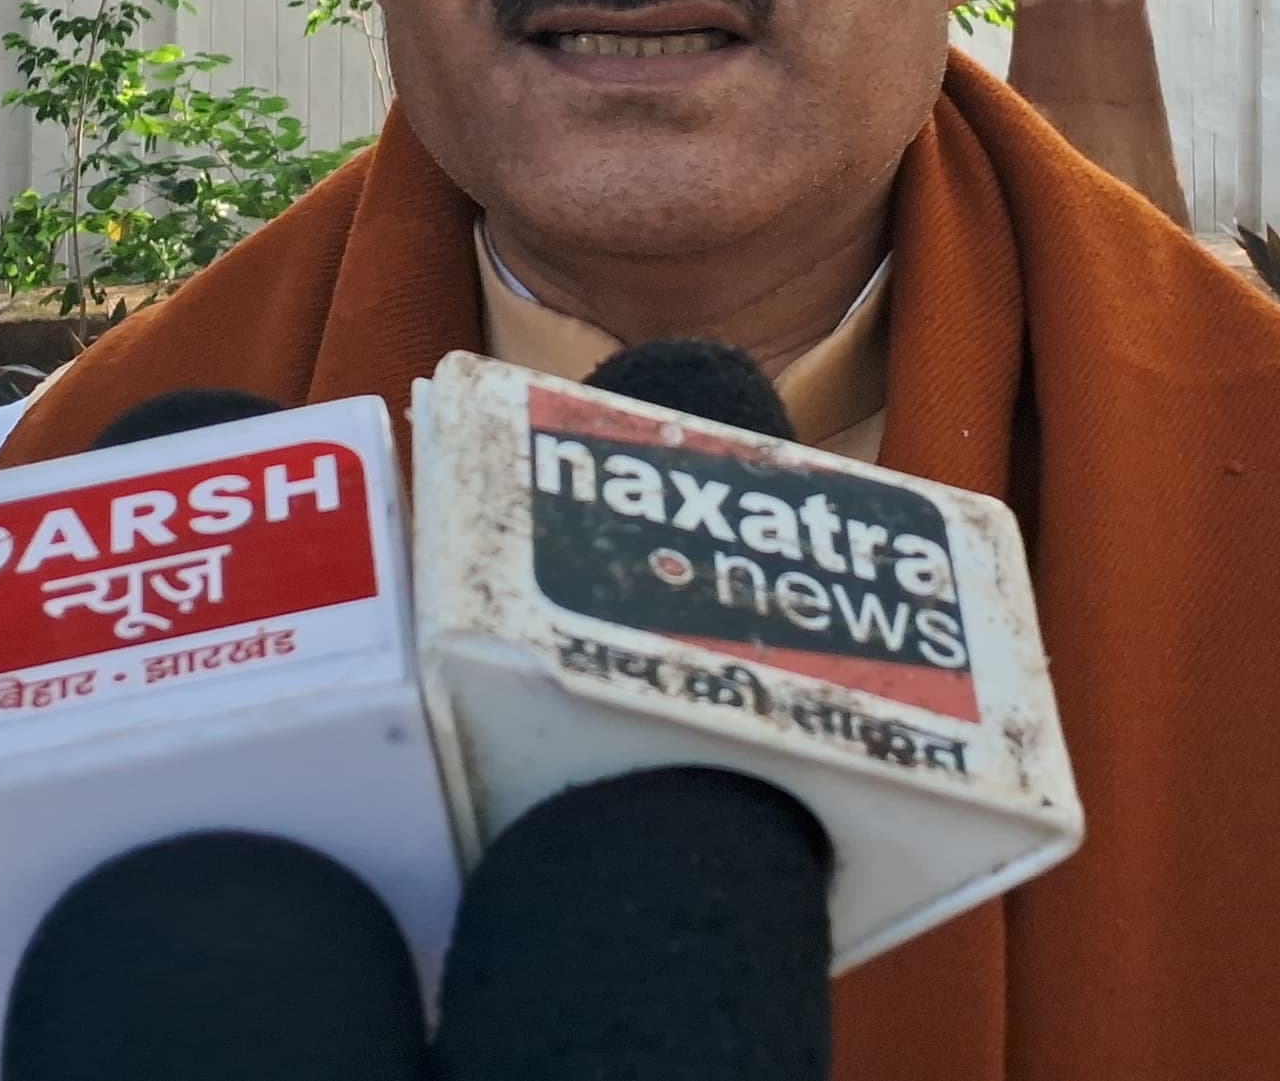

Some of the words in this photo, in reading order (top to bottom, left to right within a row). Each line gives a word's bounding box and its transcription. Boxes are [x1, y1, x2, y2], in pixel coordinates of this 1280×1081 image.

[534, 432, 958, 604] naxatra
[40, 545, 233, 639] न्यूज़
[715, 549, 969, 668] news
[142, 627, 296, 684] झारखंड
